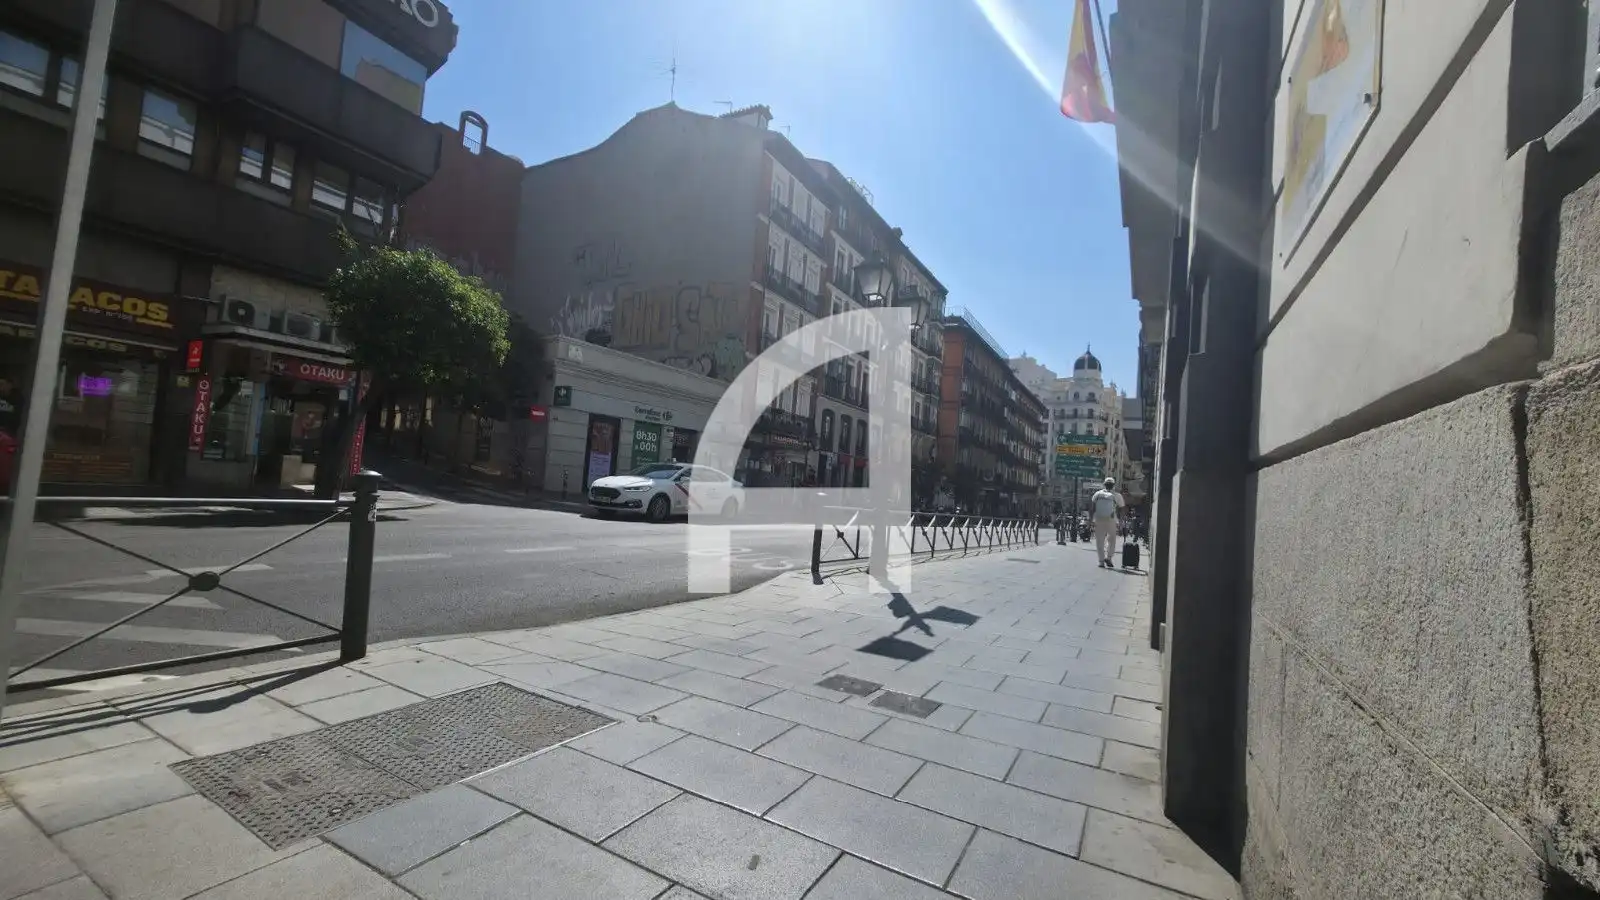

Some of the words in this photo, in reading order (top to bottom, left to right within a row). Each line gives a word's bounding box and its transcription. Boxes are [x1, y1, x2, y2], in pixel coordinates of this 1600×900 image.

[0, 269, 169, 322] TAACOS
[300, 363, 344, 380] OTAKU
[193, 380, 209, 434] OTAKU
[636, 430, 657, 442] 8h30
